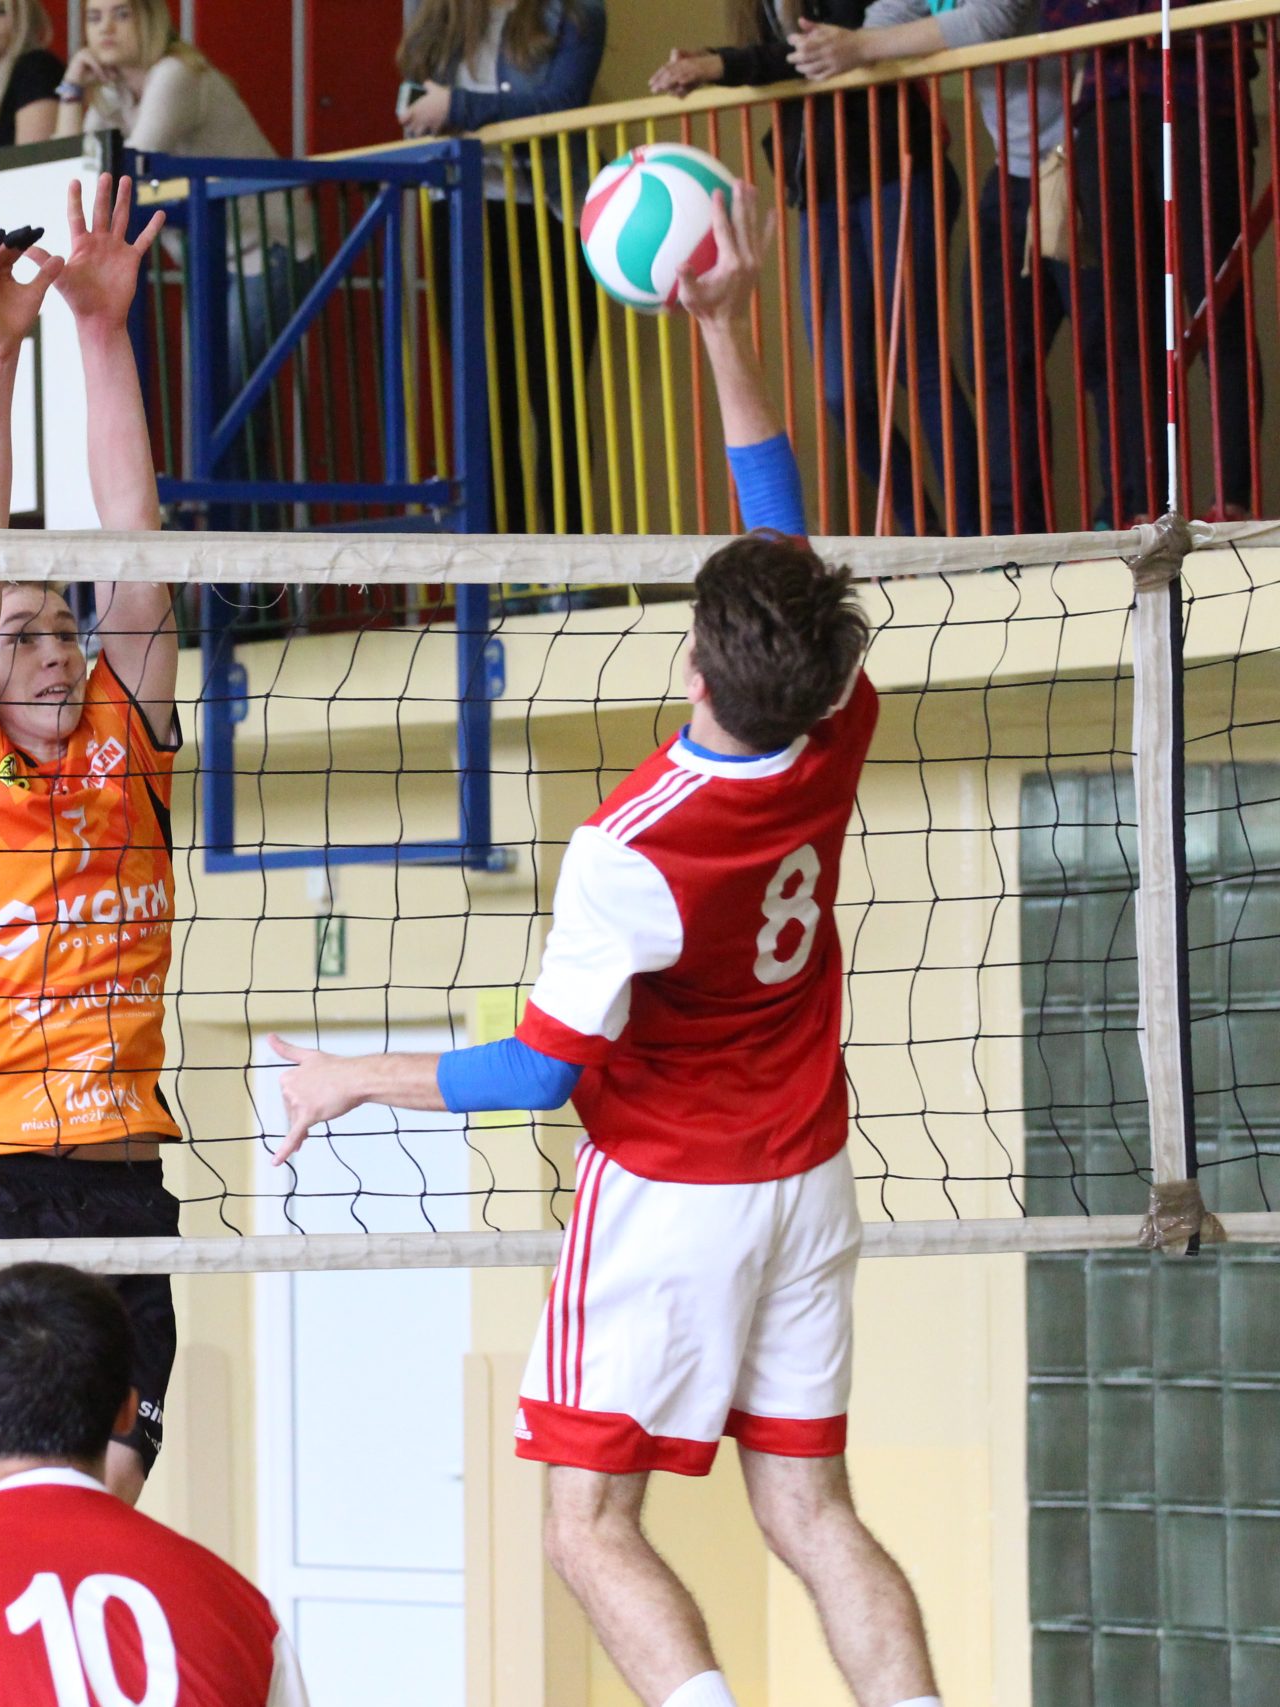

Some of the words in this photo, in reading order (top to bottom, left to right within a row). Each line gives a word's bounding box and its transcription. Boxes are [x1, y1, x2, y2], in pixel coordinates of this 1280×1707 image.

[56, 880, 168, 934] KGHM
[753, 843, 821, 985] 8
[59, 931, 131, 953] POLSKA
[138, 1399, 162, 1424] si
[4, 1572, 180, 1707] 10
